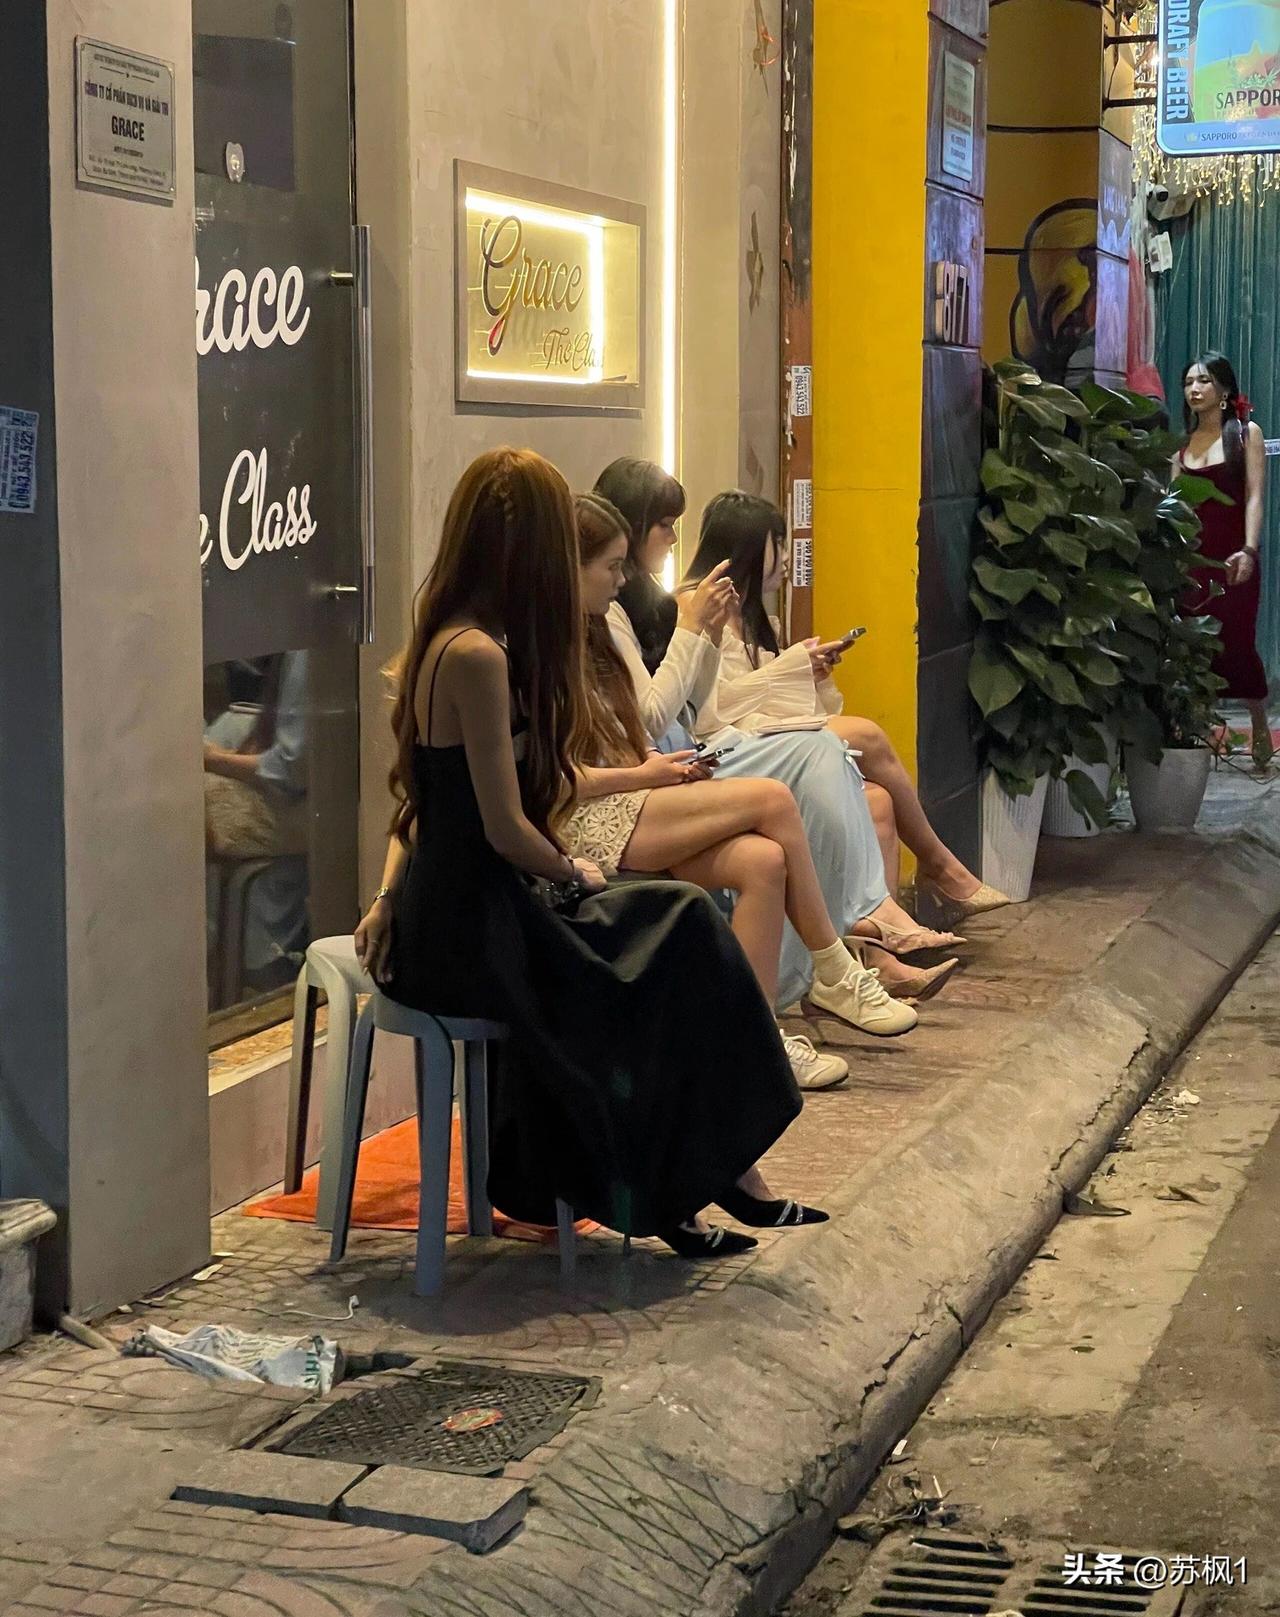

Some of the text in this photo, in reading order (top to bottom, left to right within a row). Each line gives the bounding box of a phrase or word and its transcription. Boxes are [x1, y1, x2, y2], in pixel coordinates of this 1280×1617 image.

[1166, 0, 1190, 120] DRAFT BEER
[111, 115, 144, 141] GRACE
[1215, 89, 1280, 109] SAPPOR
[1201, 131, 1238, 141] SAPPORO
[194, 255, 311, 356] race
[480, 215, 585, 357] Grace
[543, 327, 572, 370] The
[219, 447, 318, 571] Class
